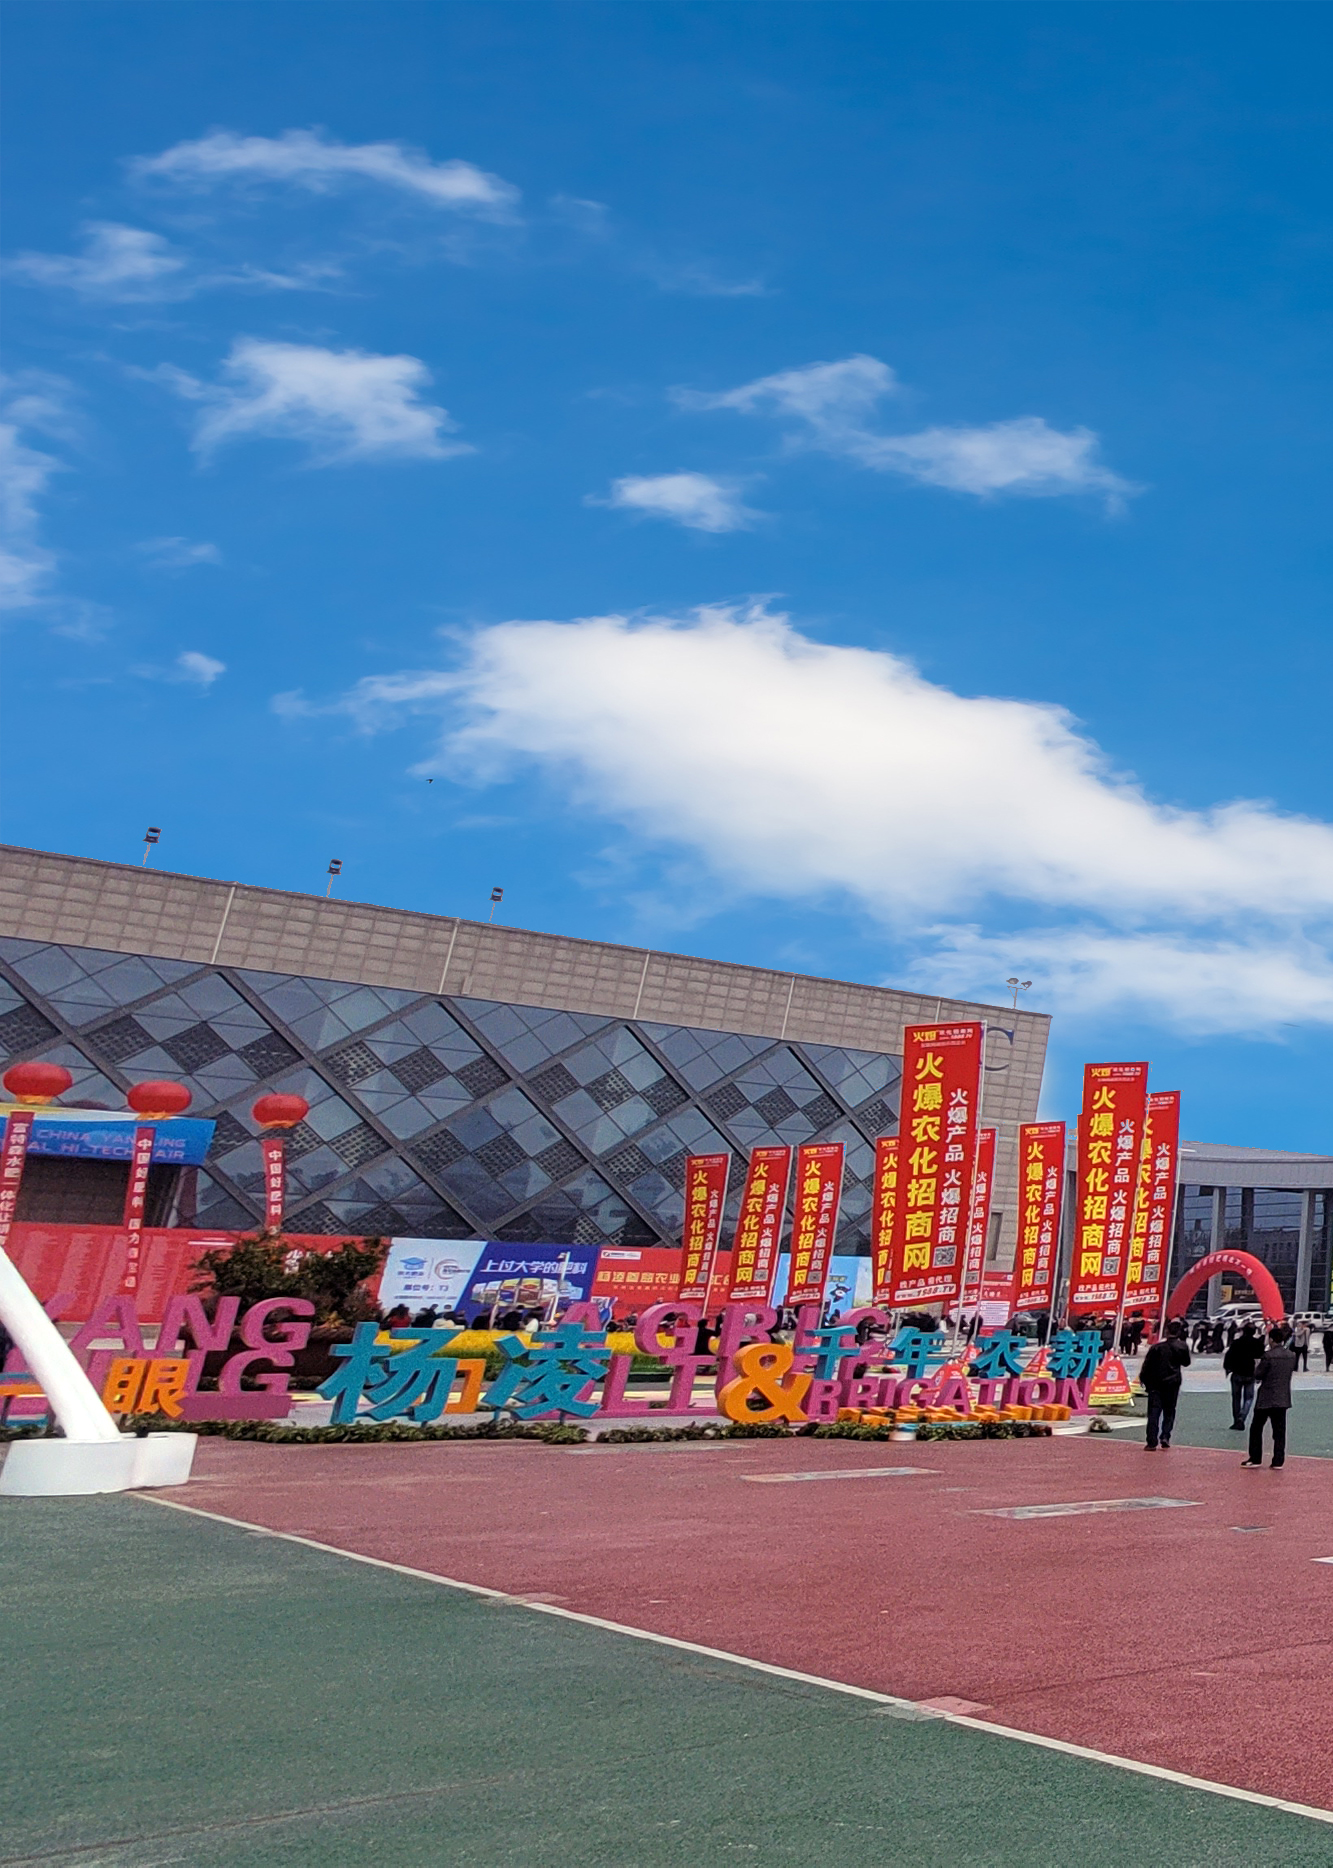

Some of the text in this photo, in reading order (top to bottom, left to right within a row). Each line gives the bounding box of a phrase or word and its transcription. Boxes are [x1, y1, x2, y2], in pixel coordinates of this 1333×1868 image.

[36, 1128, 91, 1140] CHINA
[903, 1052, 943, 1272] 火爆农化招商网
[938, 1088, 969, 1244] 火爆产品 火爆招商
[1080, 1086, 1116, 1277] 火爆农化招商网
[1107, 1119, 1135, 1256] 火爆产品 火爆招商
[684, 1170, 708, 1284] 火爆农化招商网
[736, 1162, 769, 1283] 火爆农化招商网
[794, 1160, 822, 1286] 火爆农化招商网
[1021, 1142, 1044, 1287] 火爆农化招商网
[1147, 1143, 1171, 1263] 火爆产品 火爆招商
[315, 1320, 613, 1426] 杨凌
[805, 1325, 1105, 1380] 千年农耕
